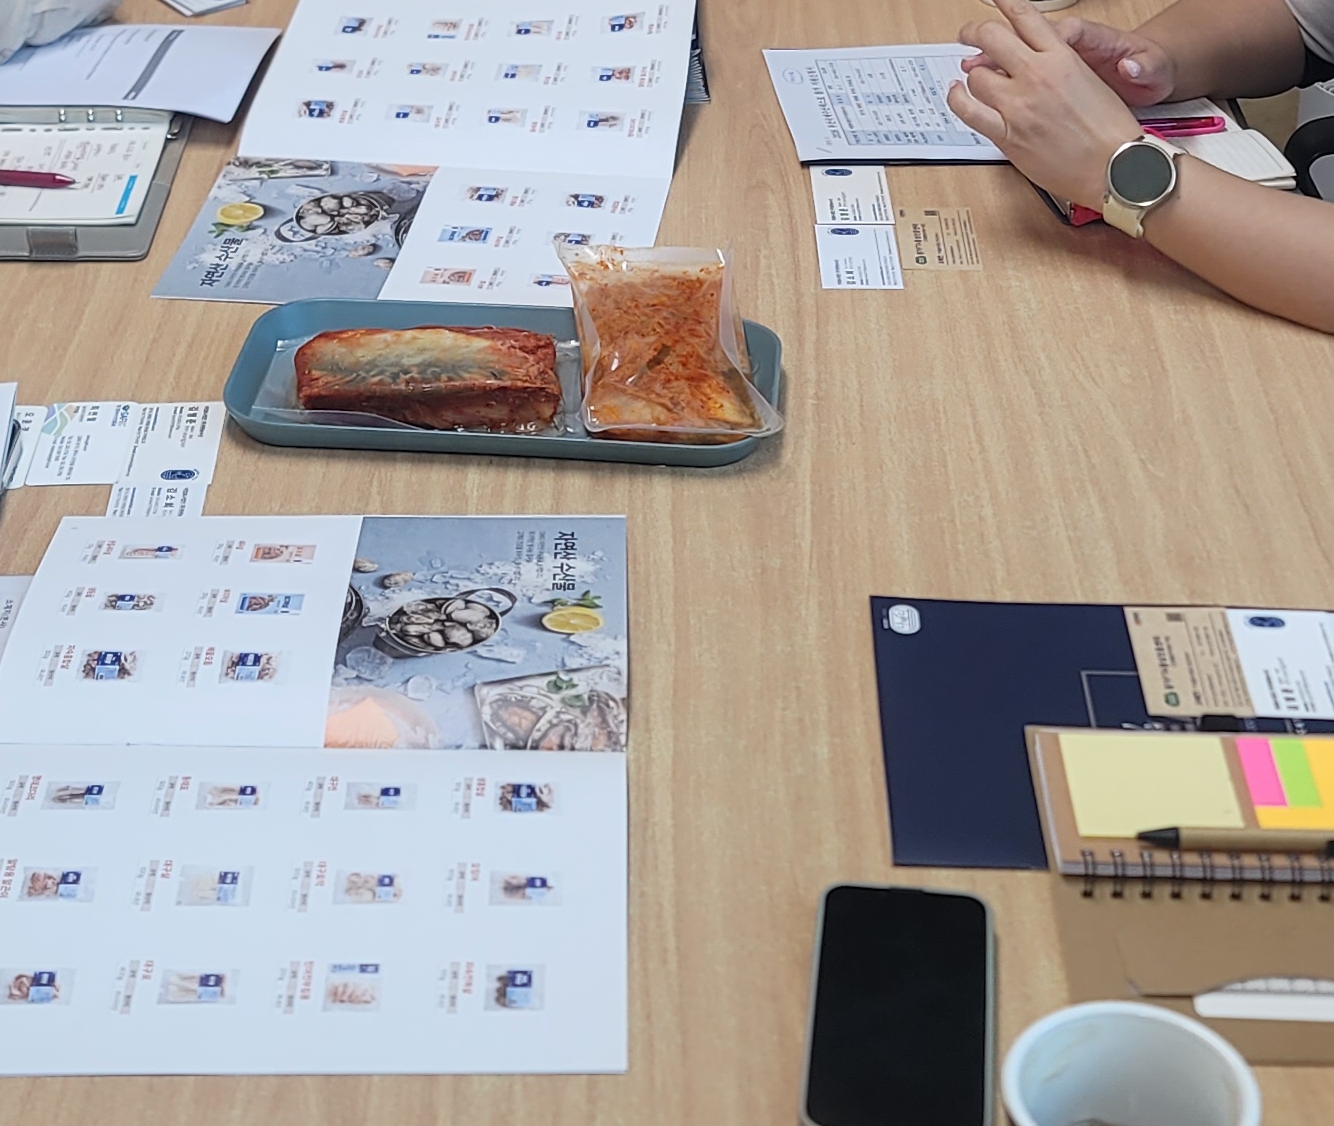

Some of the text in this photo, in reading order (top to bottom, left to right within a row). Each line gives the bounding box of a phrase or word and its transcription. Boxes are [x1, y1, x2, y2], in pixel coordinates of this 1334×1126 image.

[199, 263, 229, 287] 자연산
[215, 238, 244, 262] 수산물
[552, 530, 578, 592] 자연산 수산물
